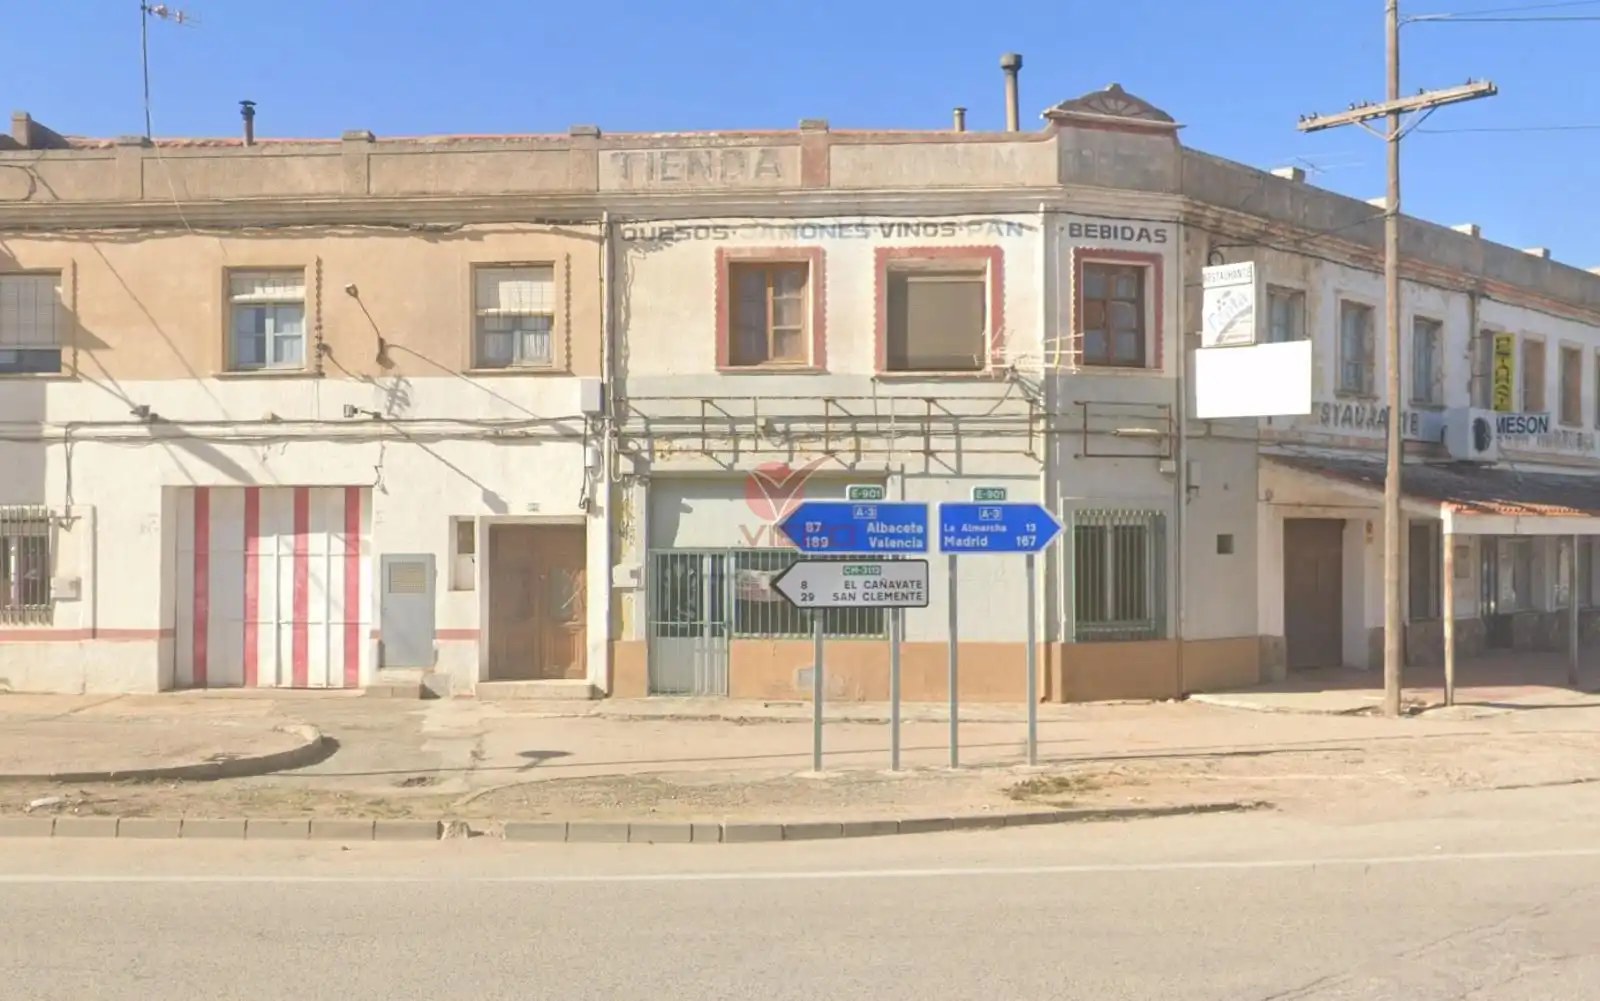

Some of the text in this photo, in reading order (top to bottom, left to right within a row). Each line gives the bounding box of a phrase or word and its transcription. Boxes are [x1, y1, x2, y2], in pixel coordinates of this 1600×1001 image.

[611, 149, 782, 182] TIENDA
[879, 221, 957, 239] VINOS
[1068, 222, 1168, 244] BEBIDAS
[1496, 416, 1550, 434] MESON
[851, 489, 881, 499] E-901
[975, 490, 1005, 499] E-901
[856, 506, 875, 517] A-3
[981, 508, 1000, 519] A-3
[867, 522, 924, 534] Albacete
[944, 523, 1037, 533] La Almarcha 13
[805, 536, 923, 549] 189 Valencia
[944, 536, 1037, 548] Madrid 167
[800, 578, 923, 590] 8 EL CAÑAVATE
[800, 592, 923, 602] 29 SAN CLEMENTE
